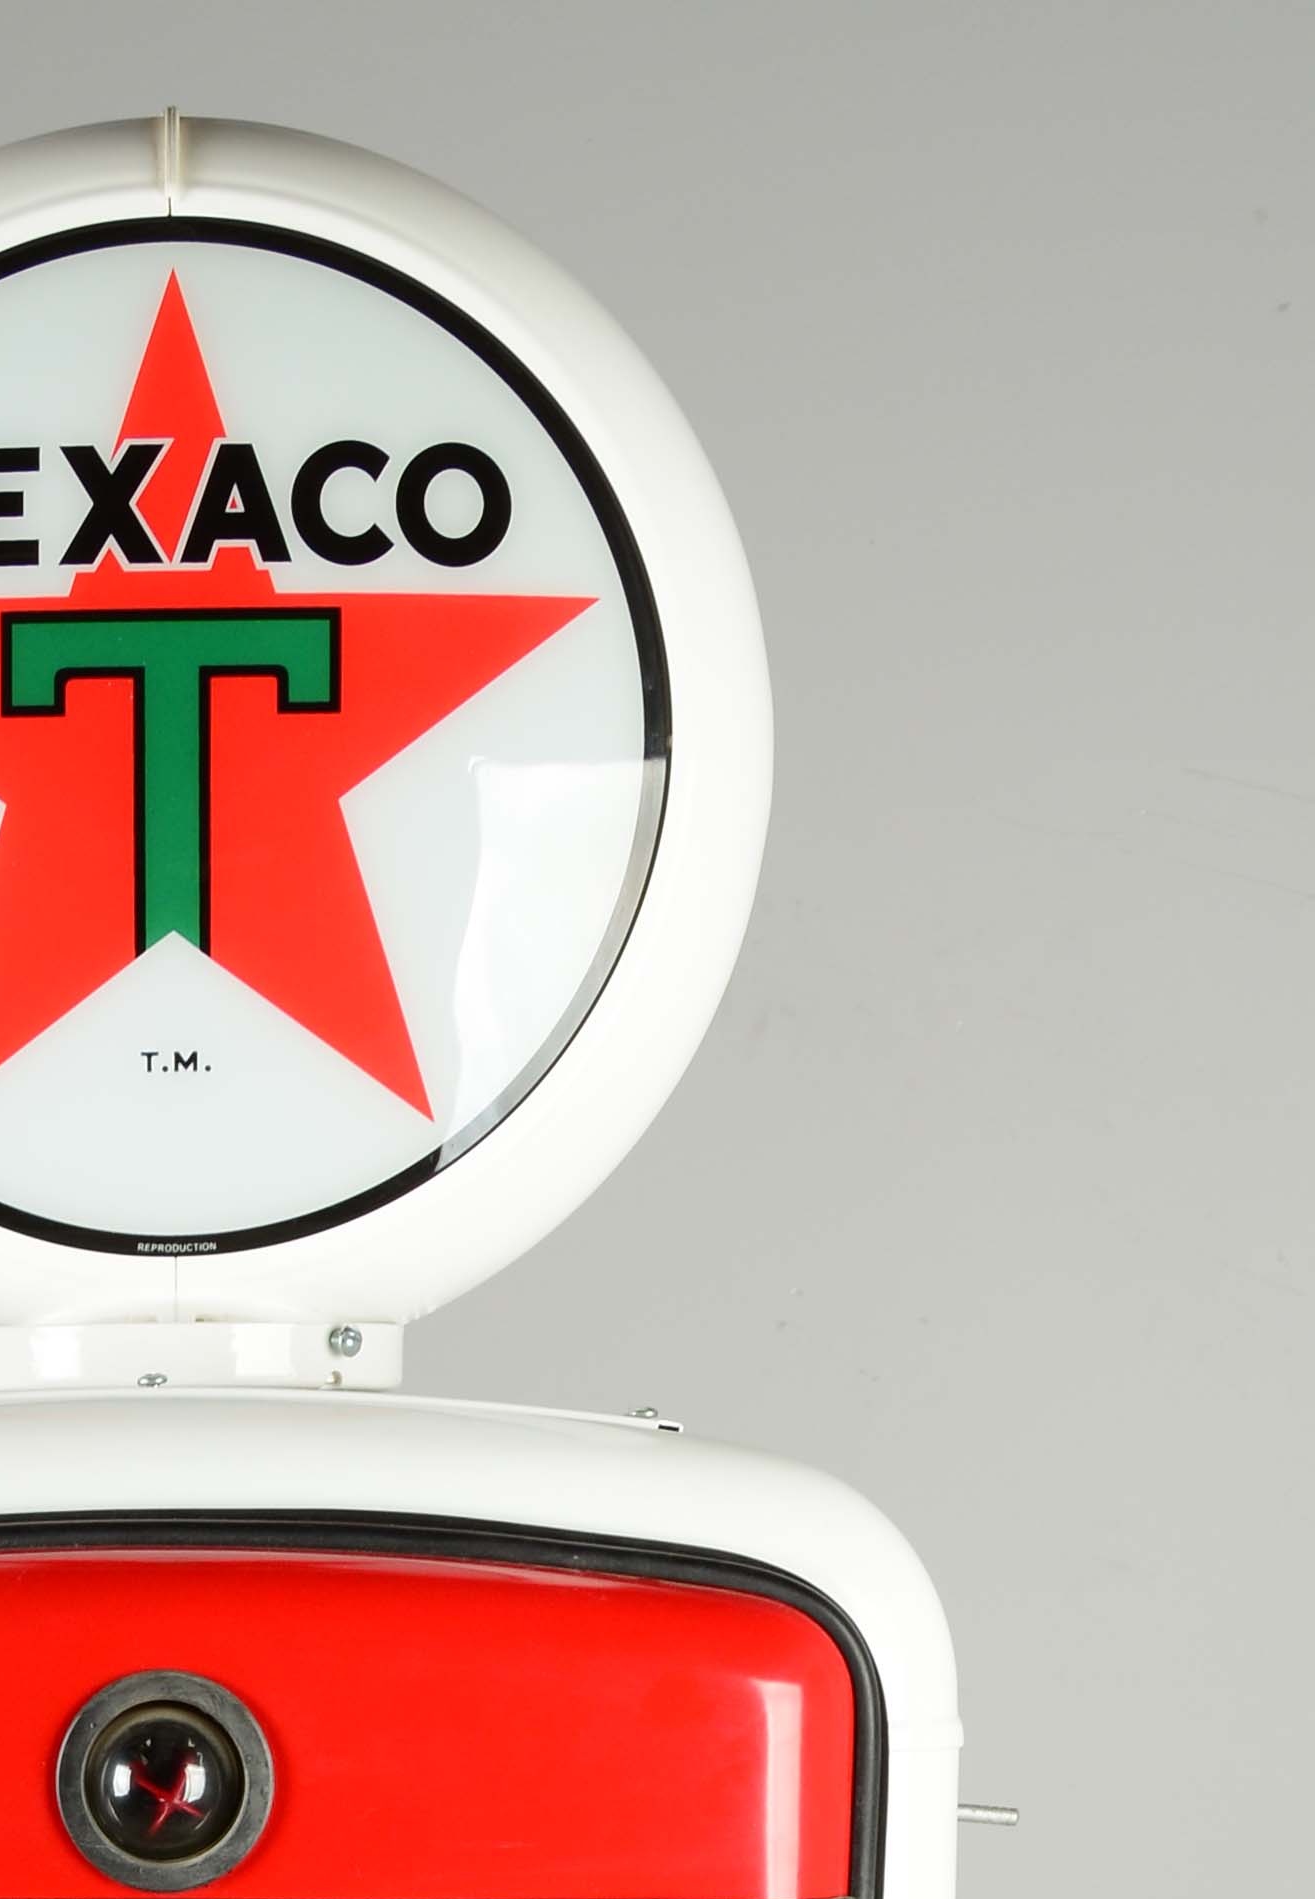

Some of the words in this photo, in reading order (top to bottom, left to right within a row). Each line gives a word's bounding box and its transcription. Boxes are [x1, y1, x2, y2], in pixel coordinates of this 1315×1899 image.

[1, 606, 341, 958] T
[140, 1051, 212, 1073] T.M.
[137, 1241, 217, 1253] REPRODUCTION
